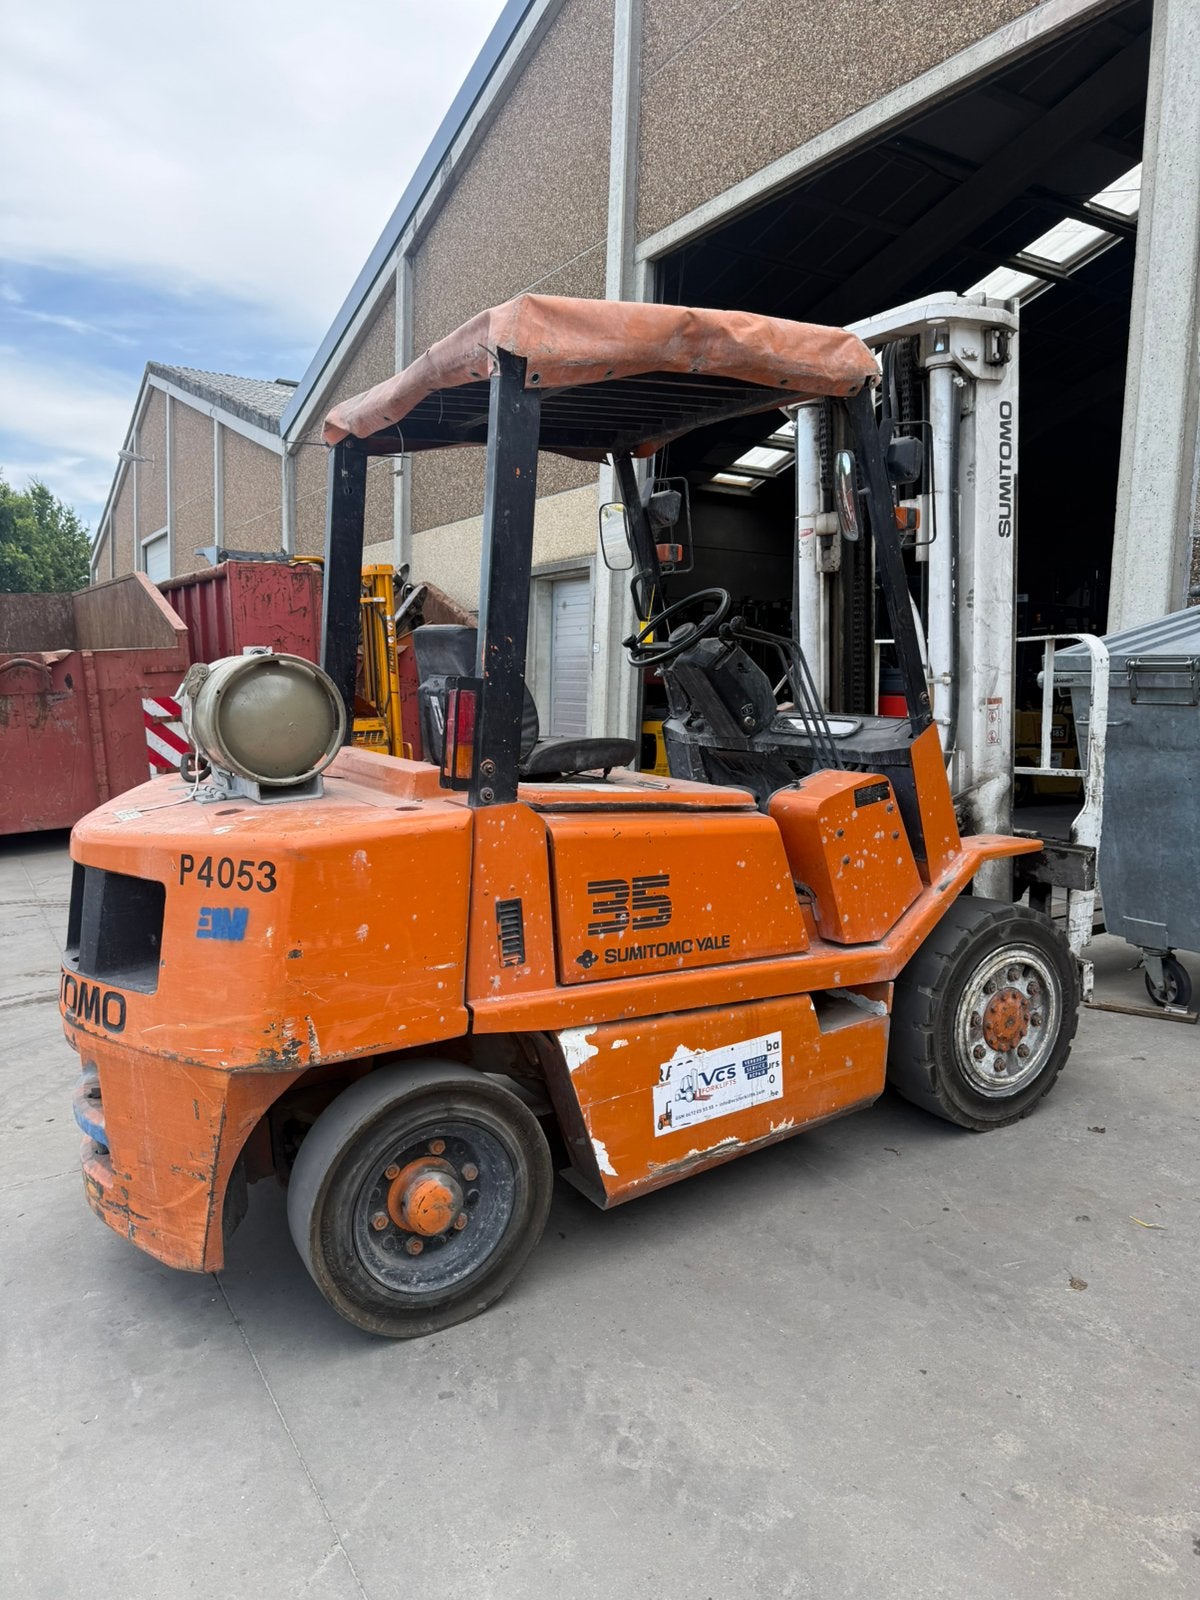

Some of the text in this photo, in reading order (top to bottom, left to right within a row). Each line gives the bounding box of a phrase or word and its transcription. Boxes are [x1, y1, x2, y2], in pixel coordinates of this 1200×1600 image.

[999, 401, 1012, 538] SUMITOMO
[180, 854, 277, 893] P4053
[587, 874, 672, 936] 35
[604, 935, 730, 964] SUMITOMO YALE
[698, 1063, 736, 1086] VCS
[701, 1079, 736, 1094] FORKLIFTS
